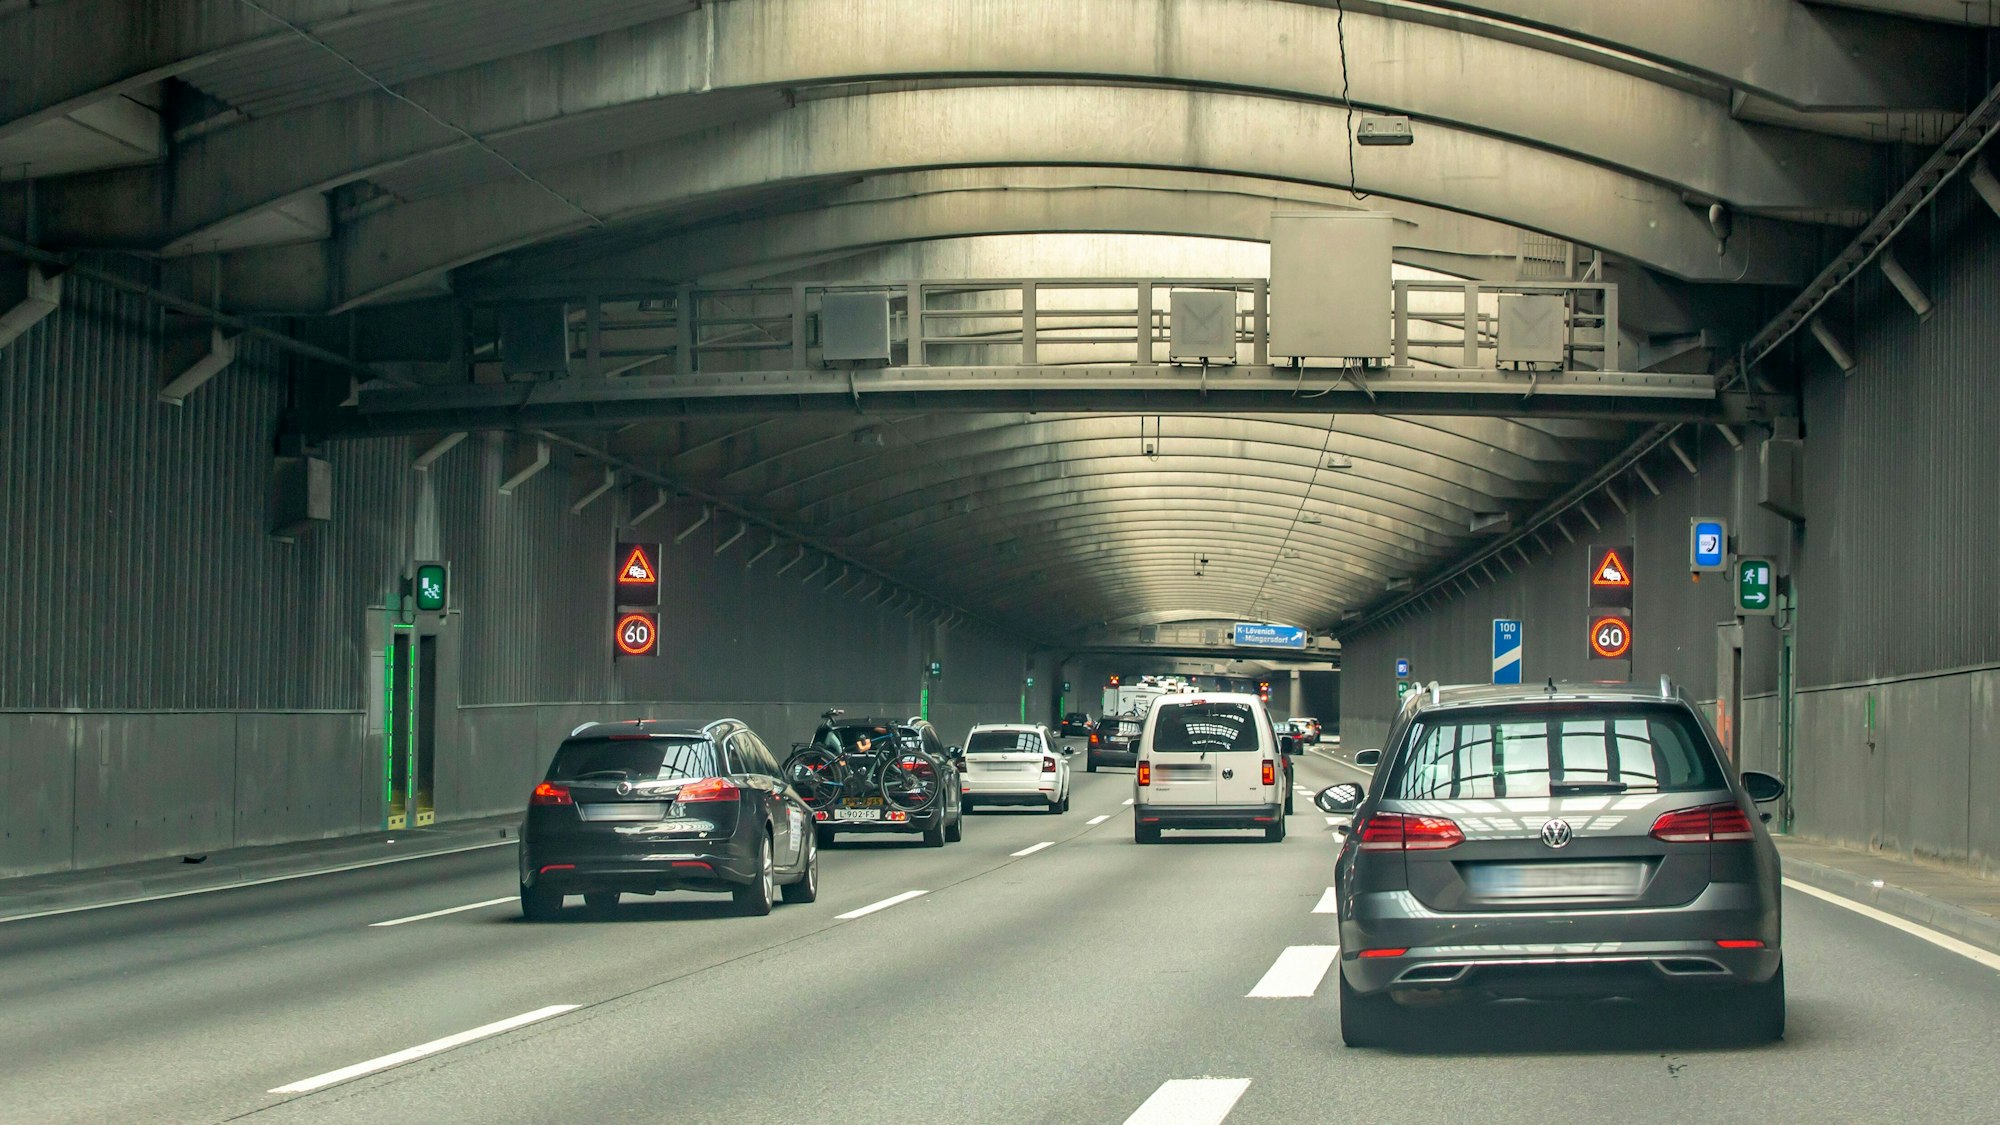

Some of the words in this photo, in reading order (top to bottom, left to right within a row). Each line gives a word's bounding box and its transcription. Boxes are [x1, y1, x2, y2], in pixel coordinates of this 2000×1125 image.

[625, 626, 648, 643] 60
[1500, 623, 1516, 632] 100
[1598, 629, 1622, 646] 60
